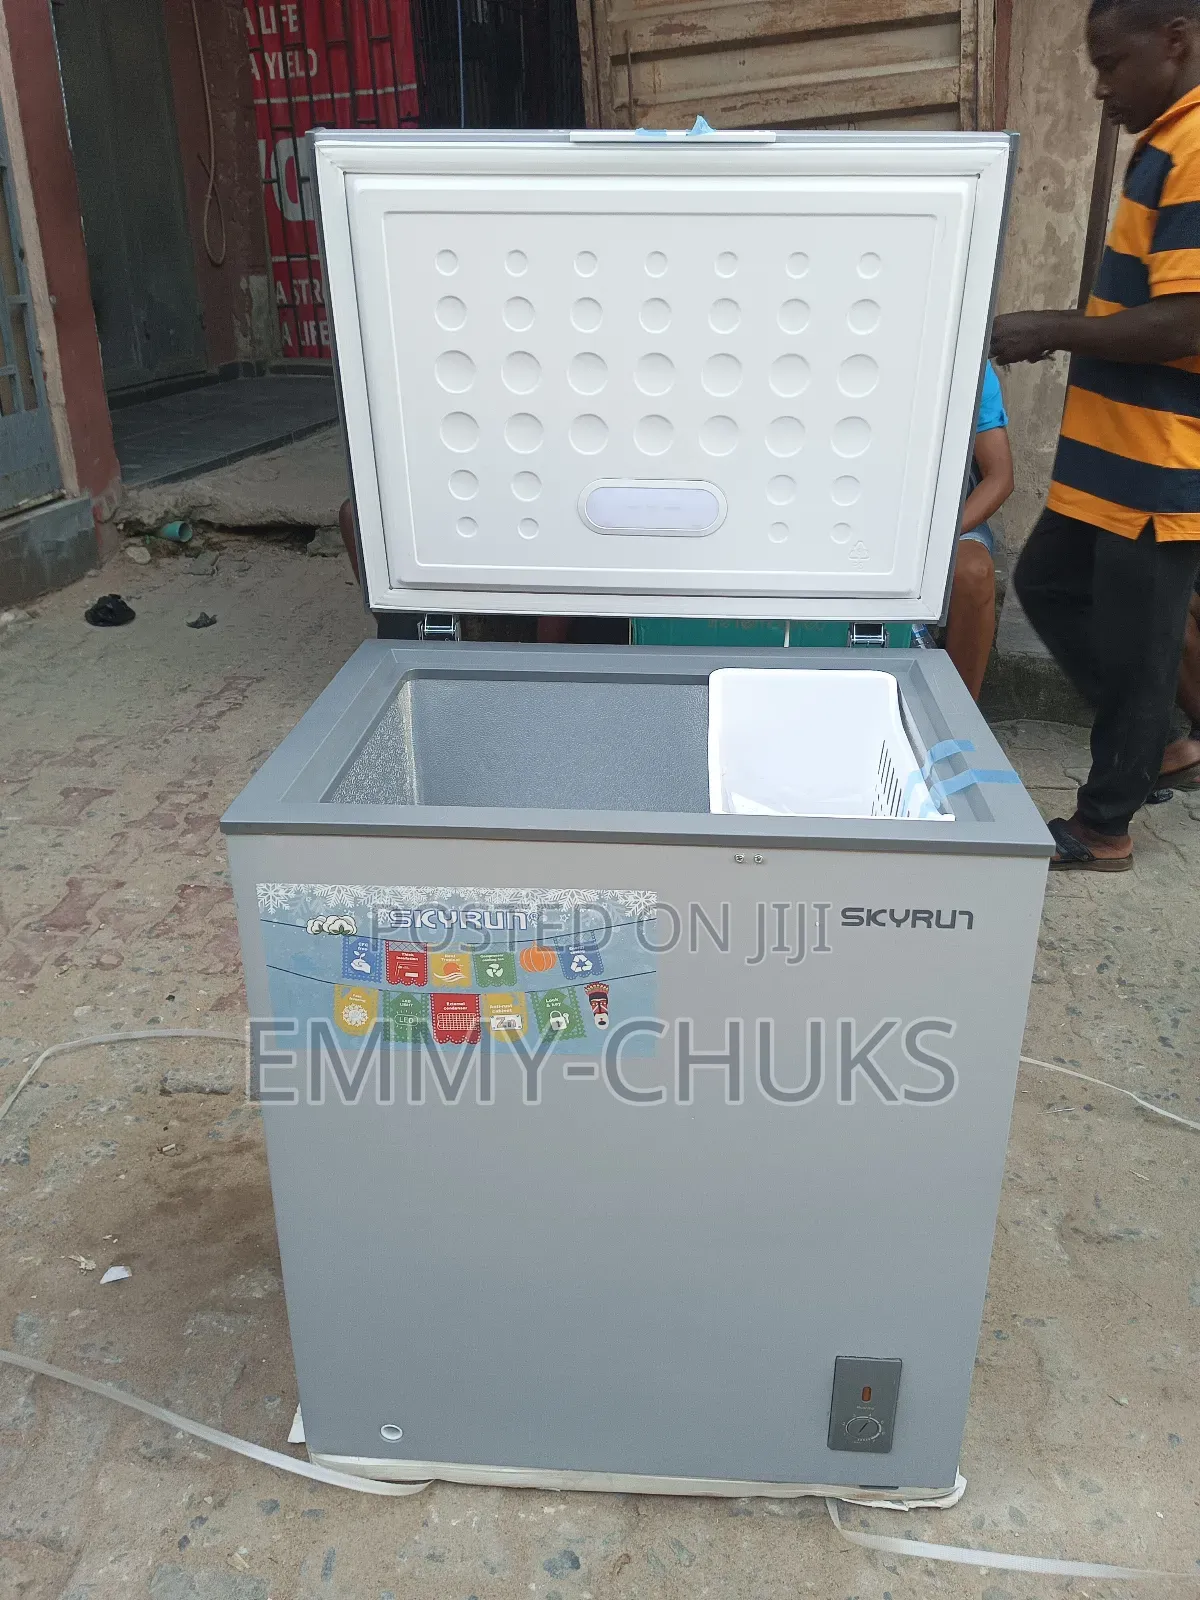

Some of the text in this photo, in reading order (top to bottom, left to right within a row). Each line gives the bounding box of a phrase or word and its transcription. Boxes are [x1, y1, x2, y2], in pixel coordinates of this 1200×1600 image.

[259, 4, 299, 34] LIFE
[264, 48, 318, 80] YIELD
[276, 281, 288, 304] A
[841, 906, 974, 930] SKYRUN
[399, 1016, 414, 1025] LED
